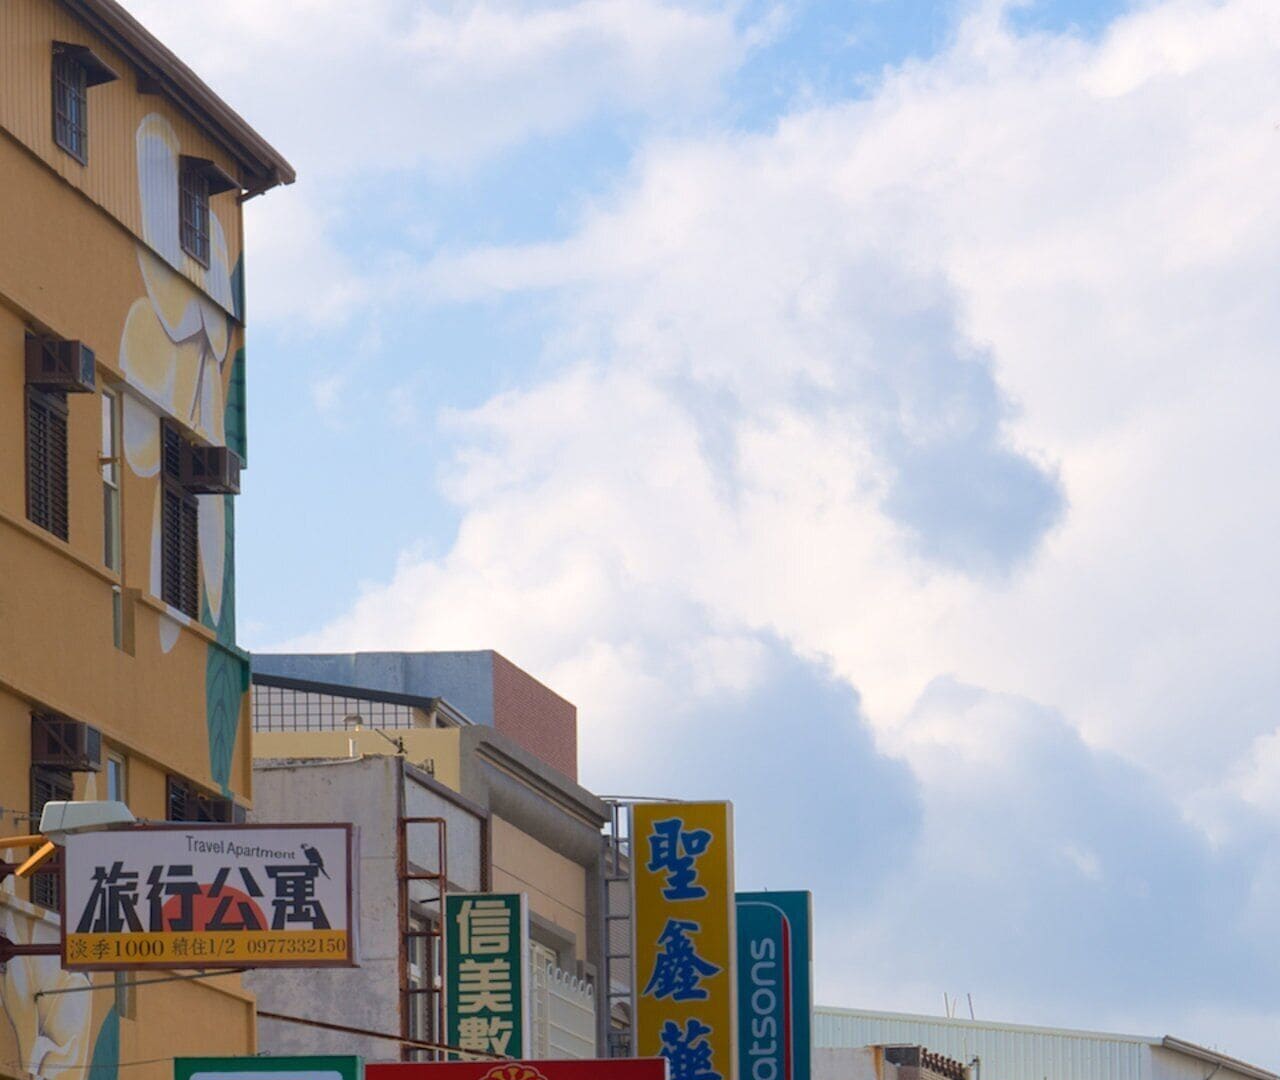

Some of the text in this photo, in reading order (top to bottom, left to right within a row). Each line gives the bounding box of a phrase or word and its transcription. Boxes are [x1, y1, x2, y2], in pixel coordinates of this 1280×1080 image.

[186, 835, 296, 859] Travel Apartment
[76, 861, 332, 933] 旅行公寓
[246, 937, 346, 953] 0977332150
